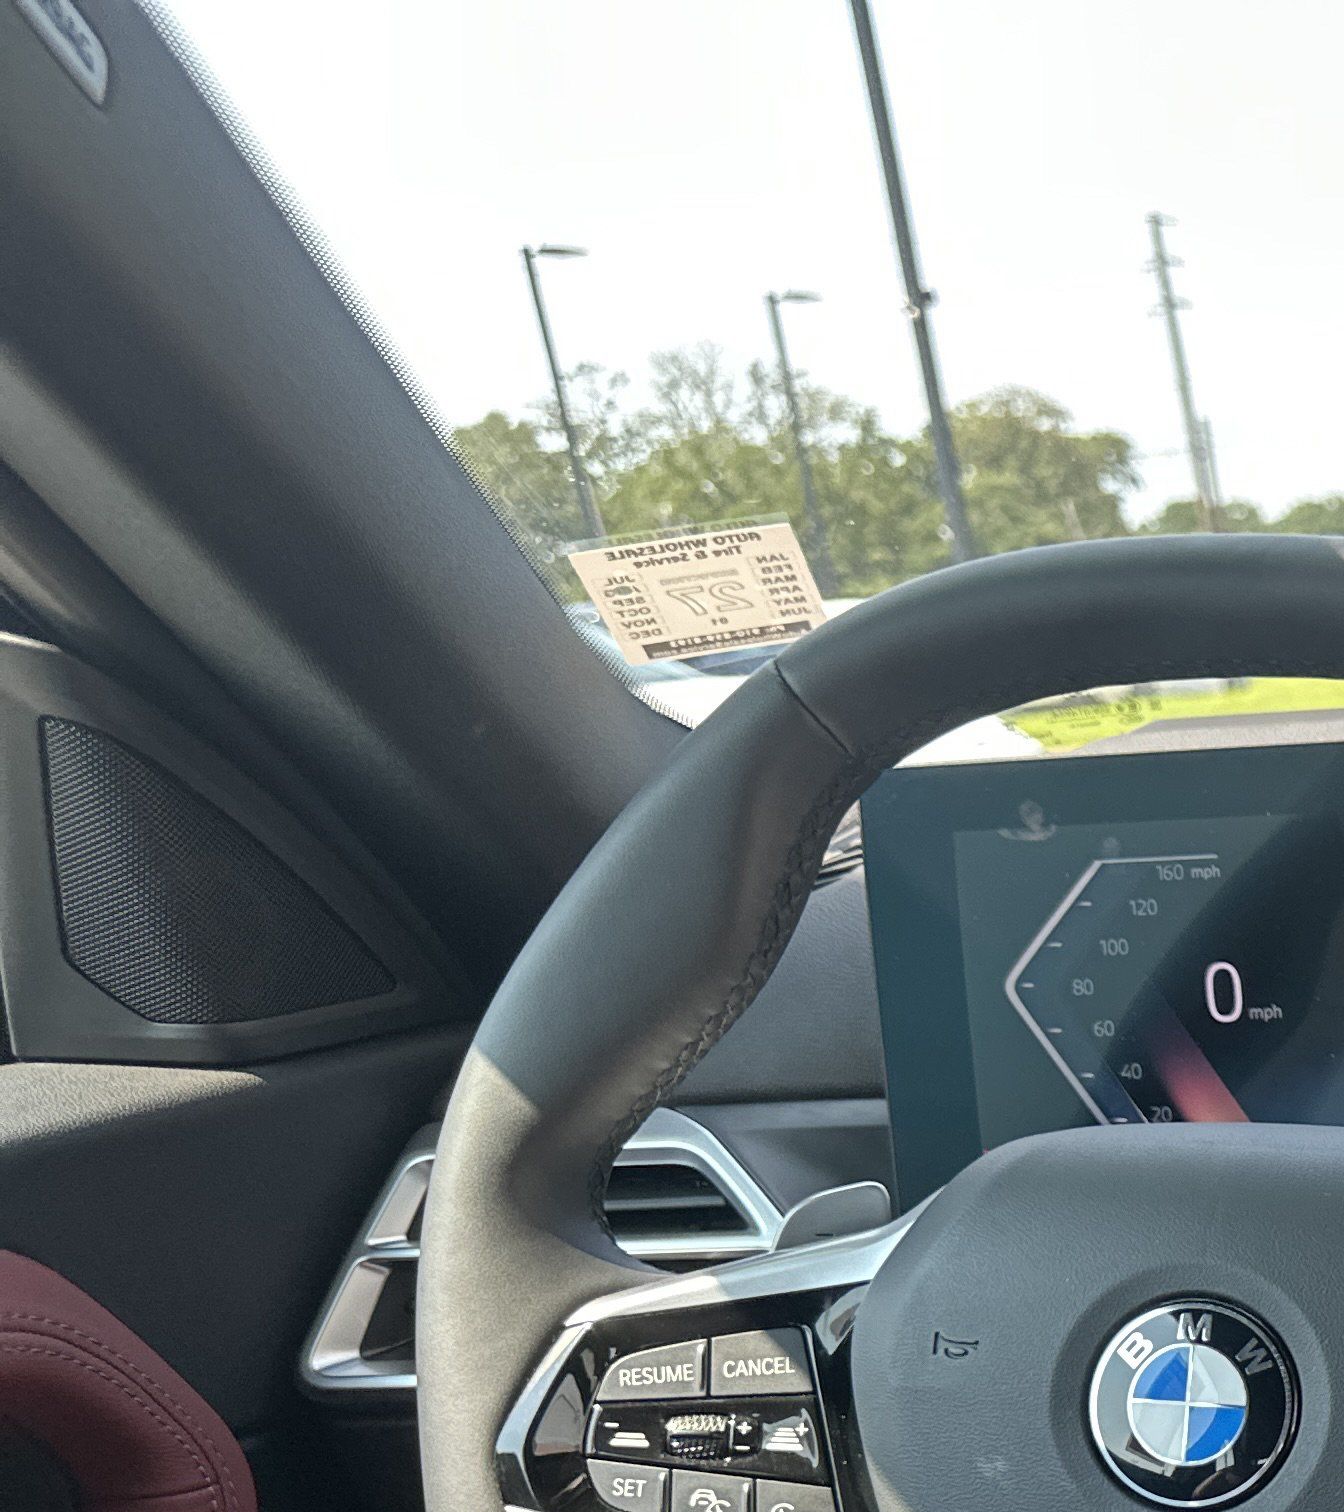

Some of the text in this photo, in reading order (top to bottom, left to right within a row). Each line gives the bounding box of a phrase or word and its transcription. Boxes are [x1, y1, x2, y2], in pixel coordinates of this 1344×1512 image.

[1155, 863, 1221, 881] 160 mph
[1129, 899, 1158, 917] 120
[1099, 938, 1129, 956] 100
[1072, 979, 1094, 996] 80
[1204, 961, 1243, 1024] 0
[1249, 1004, 1283, 1022] mph
[1093, 1020, 1115, 1037] 60
[1120, 1063, 1142, 1080] 40
[1150, 1105, 1172, 1122] 20
[1116, 1311, 1275, 1378] BMW
[618, 1363, 695, 1387] RESUME
[723, 1356, 796, 1379] CANCEL
[612, 1479, 647, 1498] SET
